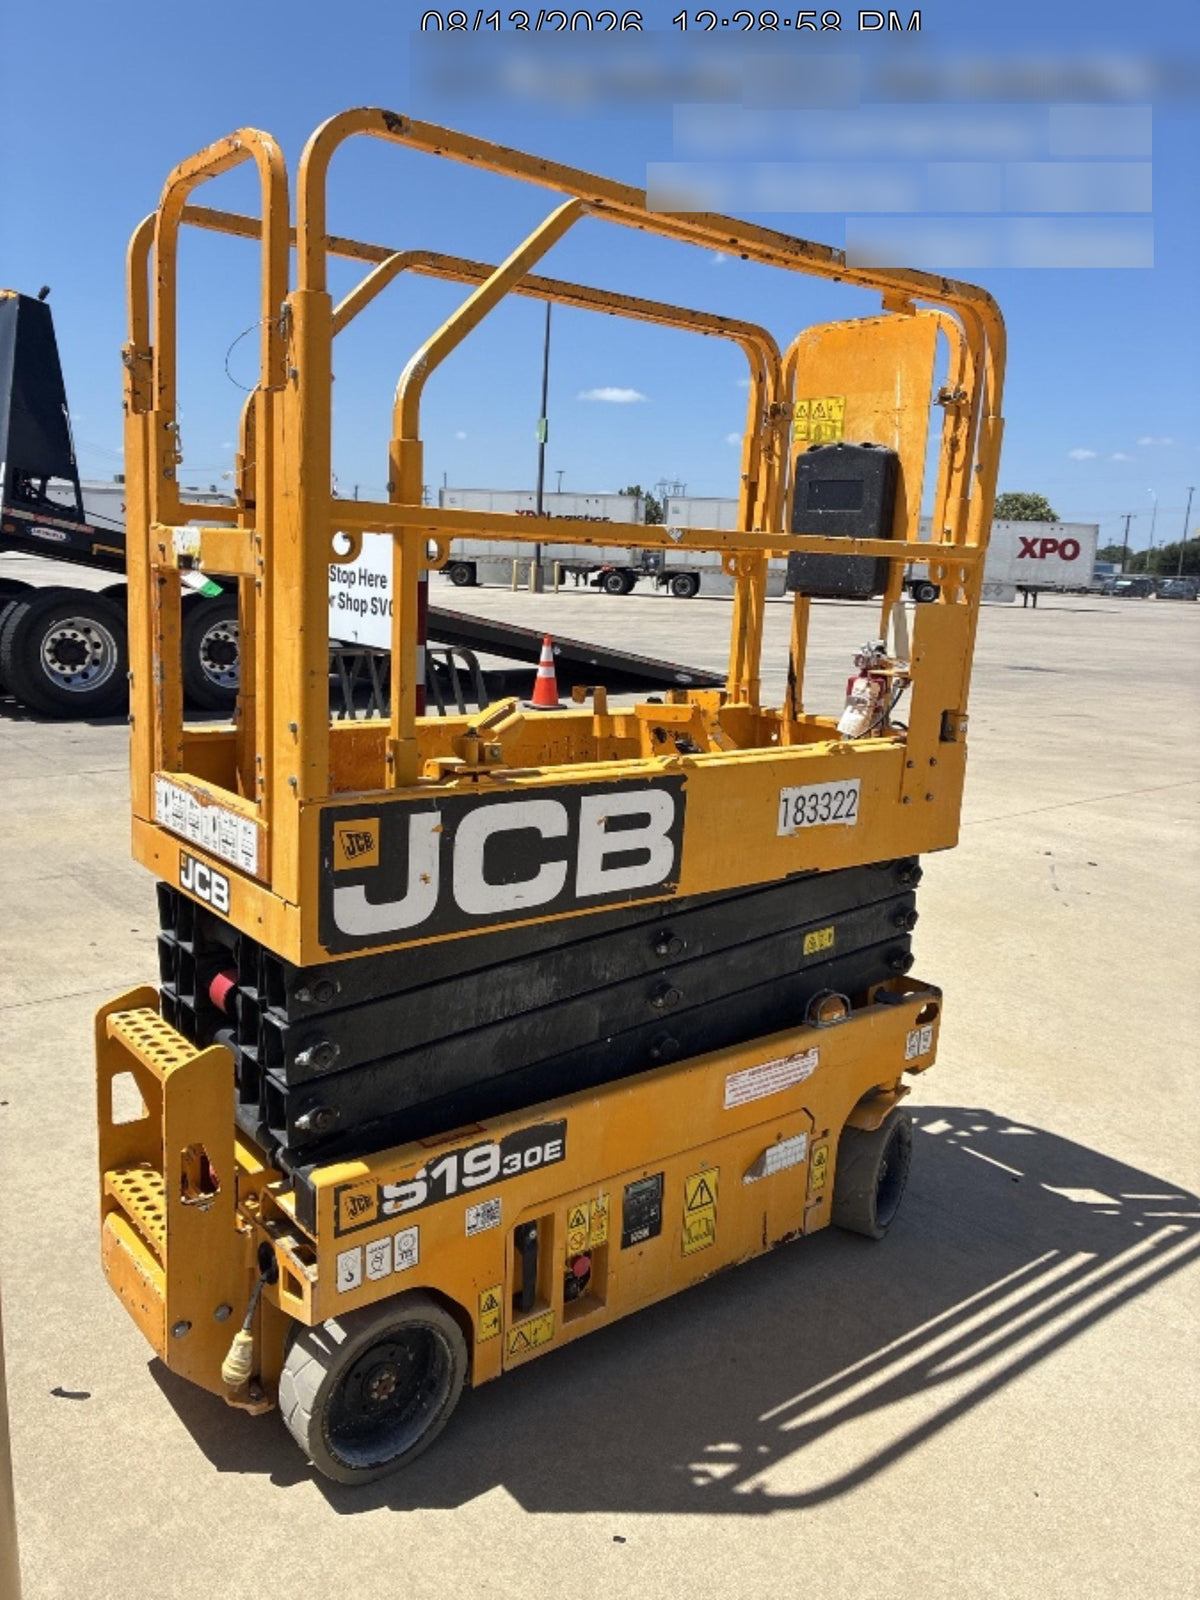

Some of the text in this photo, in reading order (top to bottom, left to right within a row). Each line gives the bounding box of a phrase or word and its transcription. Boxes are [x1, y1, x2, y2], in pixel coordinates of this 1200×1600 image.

[1017, 536, 1081, 561] XPO
[329, 565, 388, 589] Stop Here
[338, 591, 368, 618] Shop
[782, 788, 858, 828] 183322
[343, 831, 373, 857] JCB
[334, 788, 675, 936] JCB
[181, 857, 229, 913] JCB
